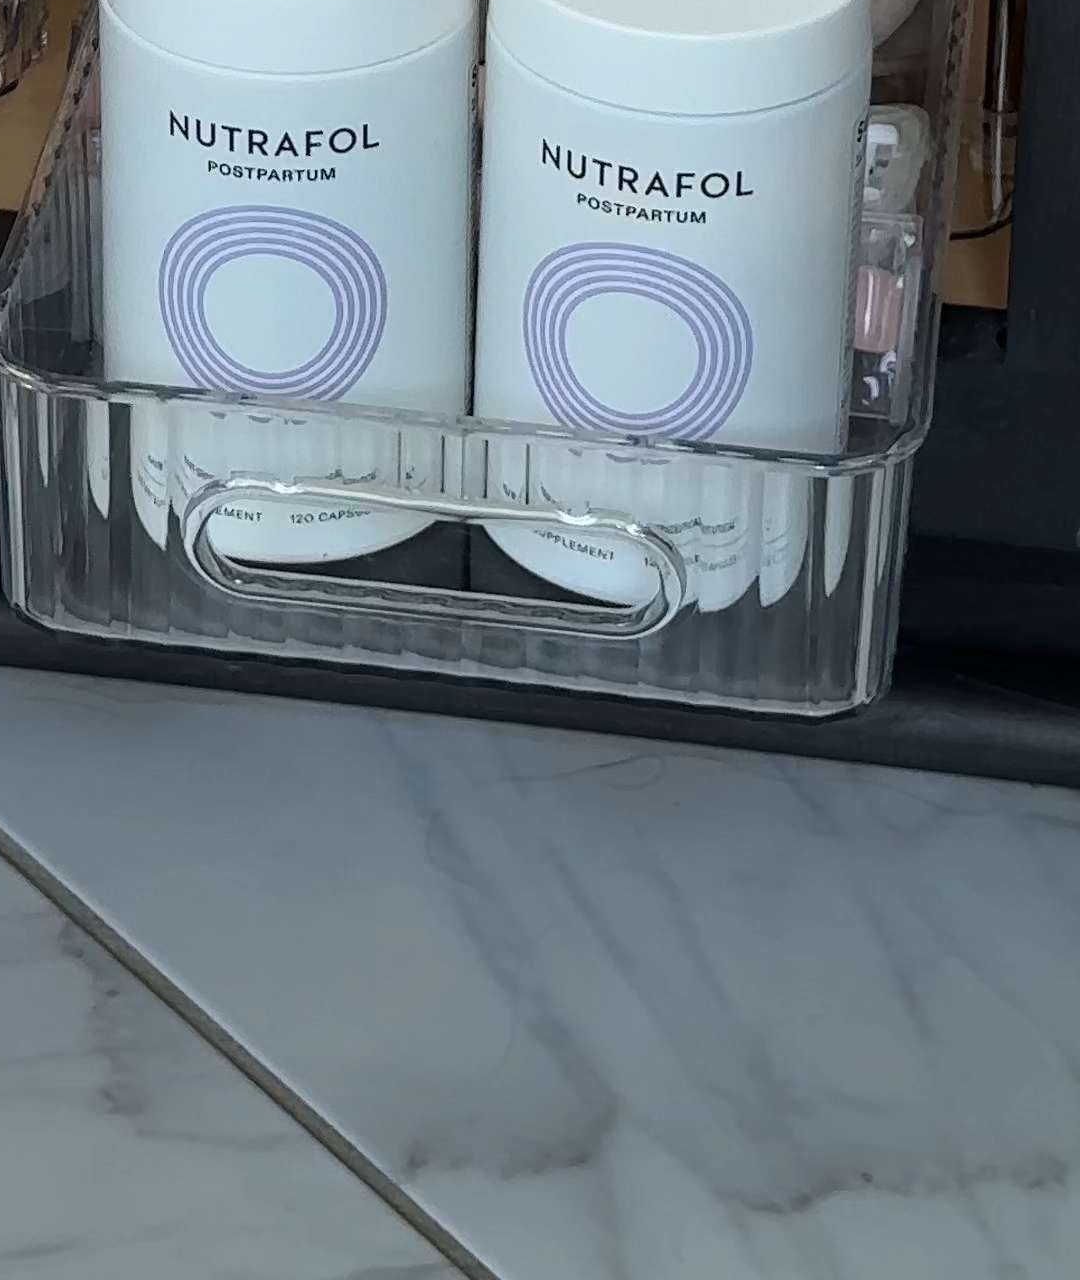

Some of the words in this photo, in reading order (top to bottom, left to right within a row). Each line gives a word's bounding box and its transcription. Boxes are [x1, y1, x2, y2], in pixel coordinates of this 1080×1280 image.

[170, 110, 380, 157] NUTRAFOL
[208, 160, 336, 182] POSTPARTUM
[542, 138, 754, 199] NUTRAFOL
[576, 193, 707, 224] POSTPARTUM
[291, 513, 314, 524] 120
